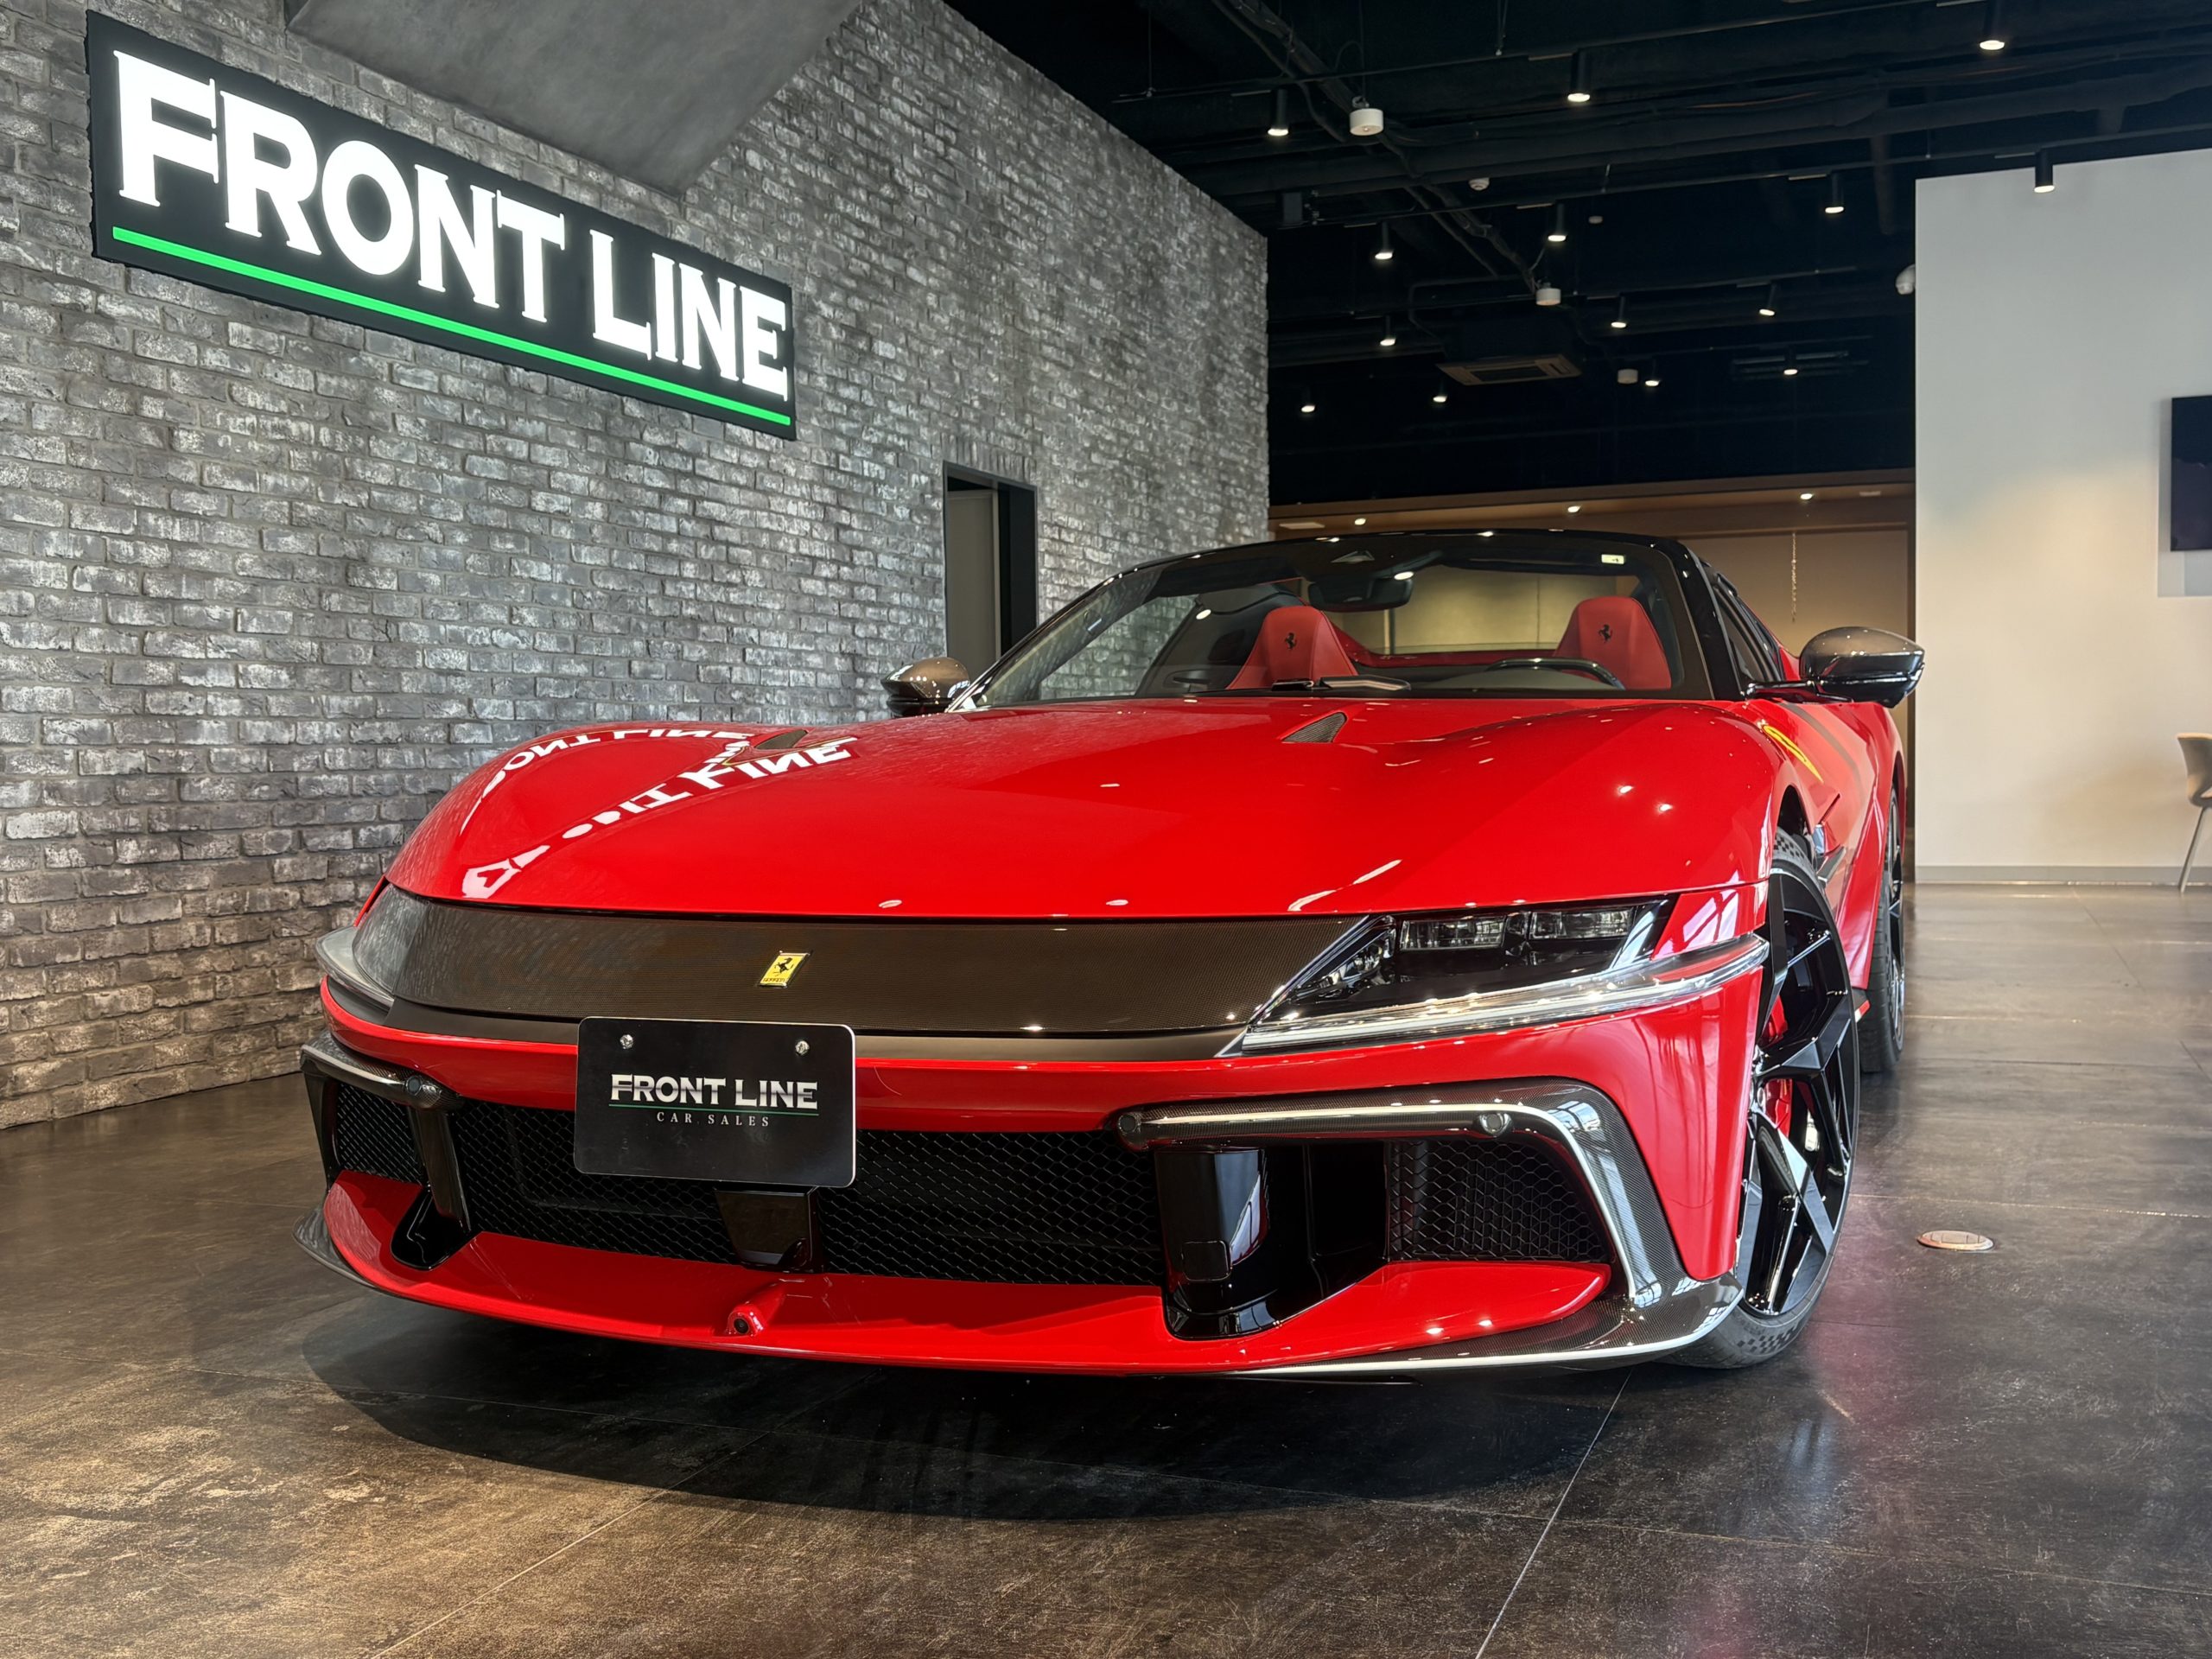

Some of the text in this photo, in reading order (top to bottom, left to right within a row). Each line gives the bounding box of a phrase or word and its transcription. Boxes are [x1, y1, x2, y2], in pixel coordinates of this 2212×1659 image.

[114, 51, 788, 402] FRONT LINE
[611, 1074, 817, 1109] FRONT LINE
[657, 1111, 769, 1127] CAR SALES
